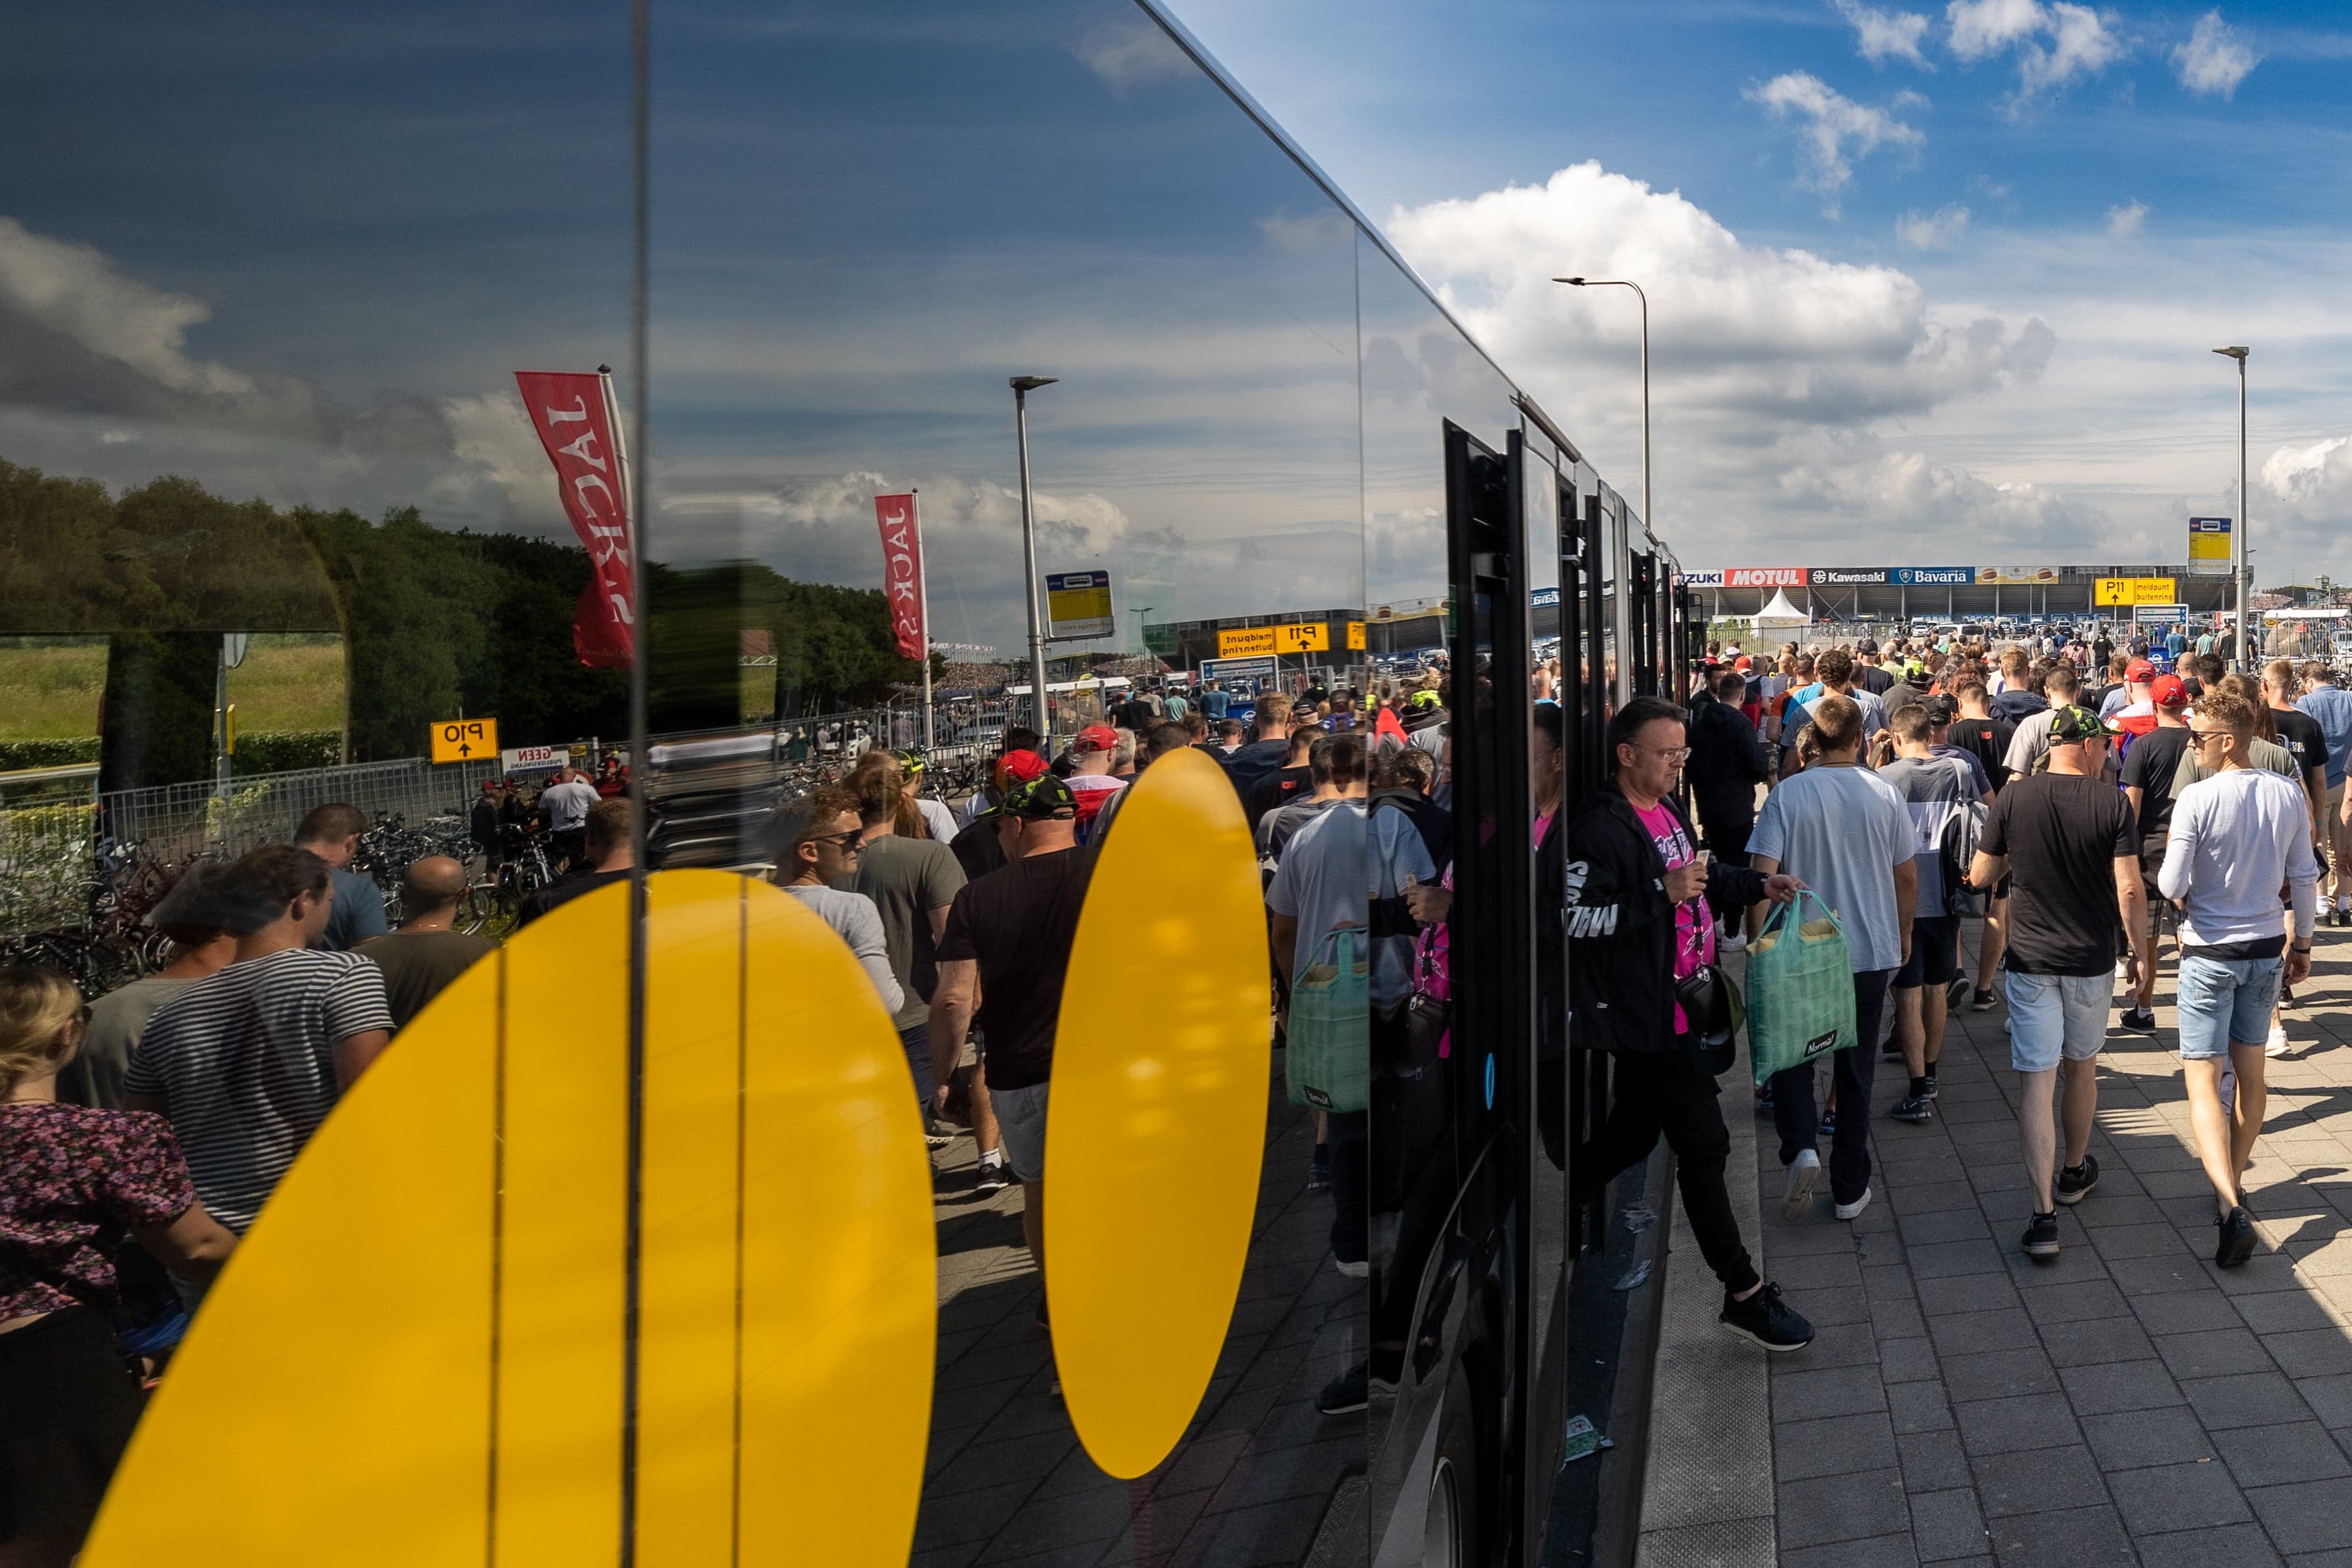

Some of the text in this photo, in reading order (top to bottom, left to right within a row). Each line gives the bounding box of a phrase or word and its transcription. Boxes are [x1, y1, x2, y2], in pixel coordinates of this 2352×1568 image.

[1732, 570, 1800, 586] MOTUL
[1829, 571, 1885, 582] Kawasaki
[1914, 570, 1967, 582] Bavaria
[2107, 581, 2124, 592] P11
[1807, 1034, 1835, 1054] Normal
